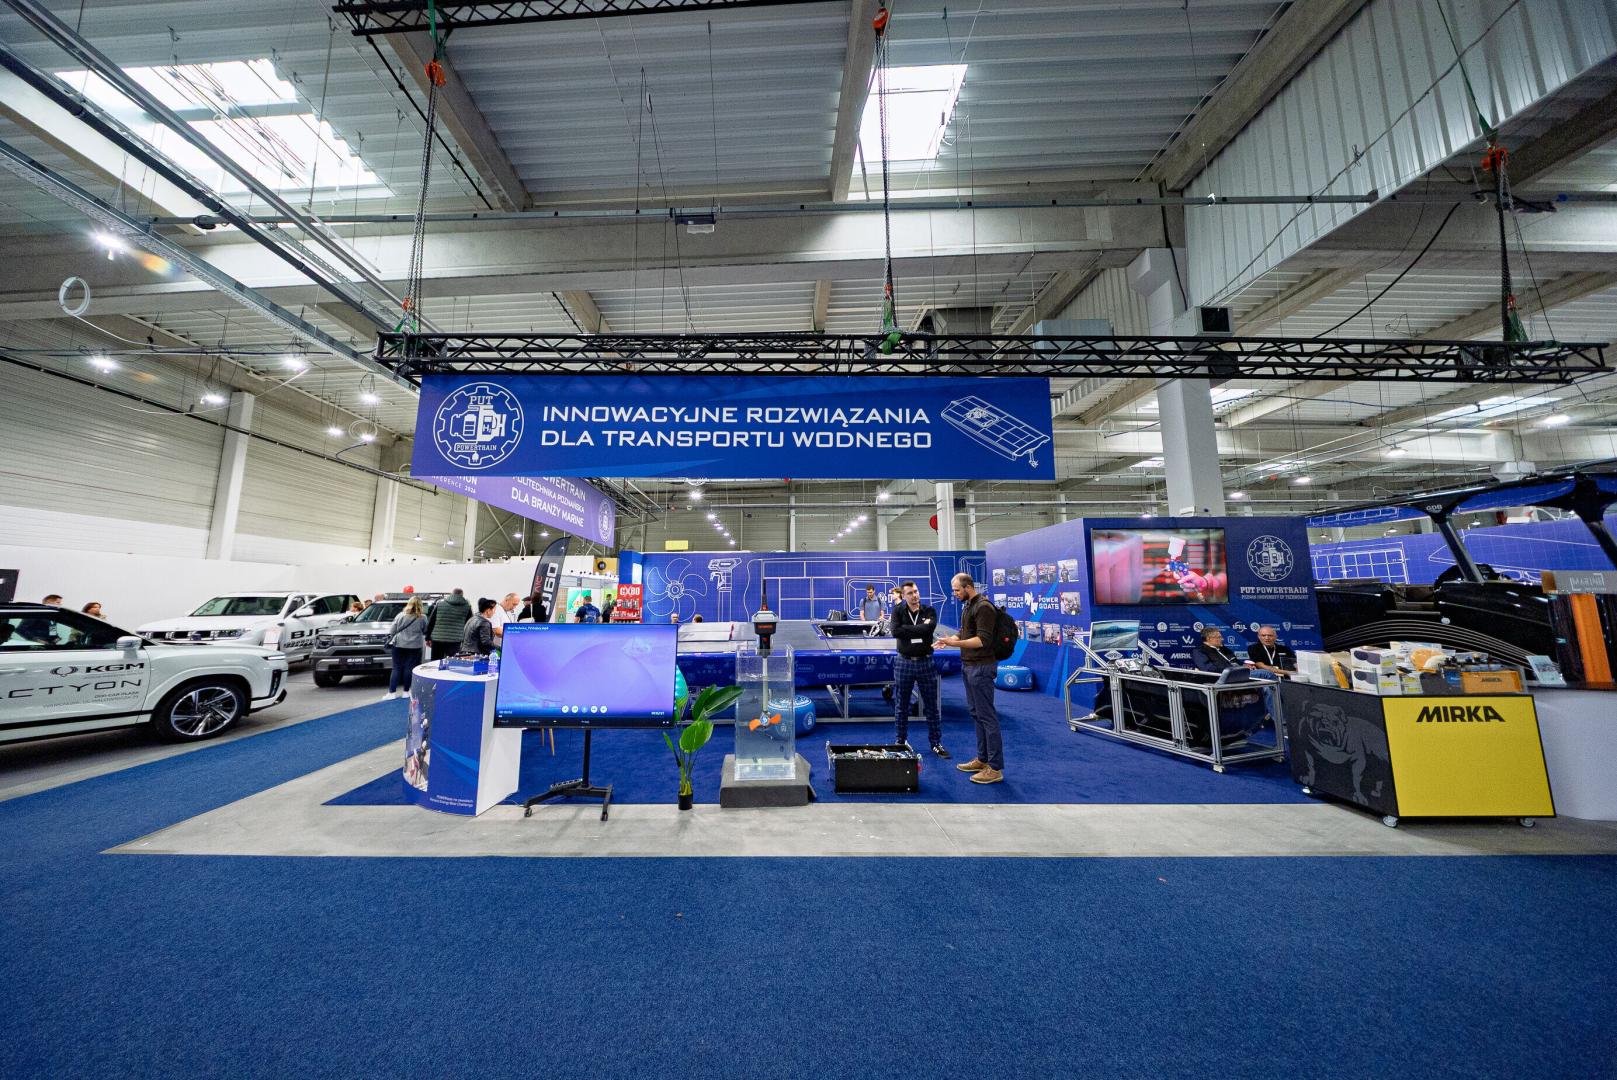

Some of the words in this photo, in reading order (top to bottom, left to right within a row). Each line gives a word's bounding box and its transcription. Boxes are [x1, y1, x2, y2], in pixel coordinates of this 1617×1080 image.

[469, 396, 493, 404] PUT
[543, 406, 737, 423] INNOWACYJNE
[746, 407, 931, 428] ROZWIĄZANIA
[541, 430, 595, 446] DLA
[601, 430, 784, 447] TRANSPORTU
[792, 431, 932, 448] WODNEGO
[511, 486, 530, 506] DLA
[531, 495, 561, 518] BRANŻY
[561, 509, 585, 528] MARINE
[1038, 595, 1059, 603] POWER
[85, 662, 145, 673] KGM
[0, 679, 142, 699] CTYON
[1416, 705, 1506, 723] MIRKA
